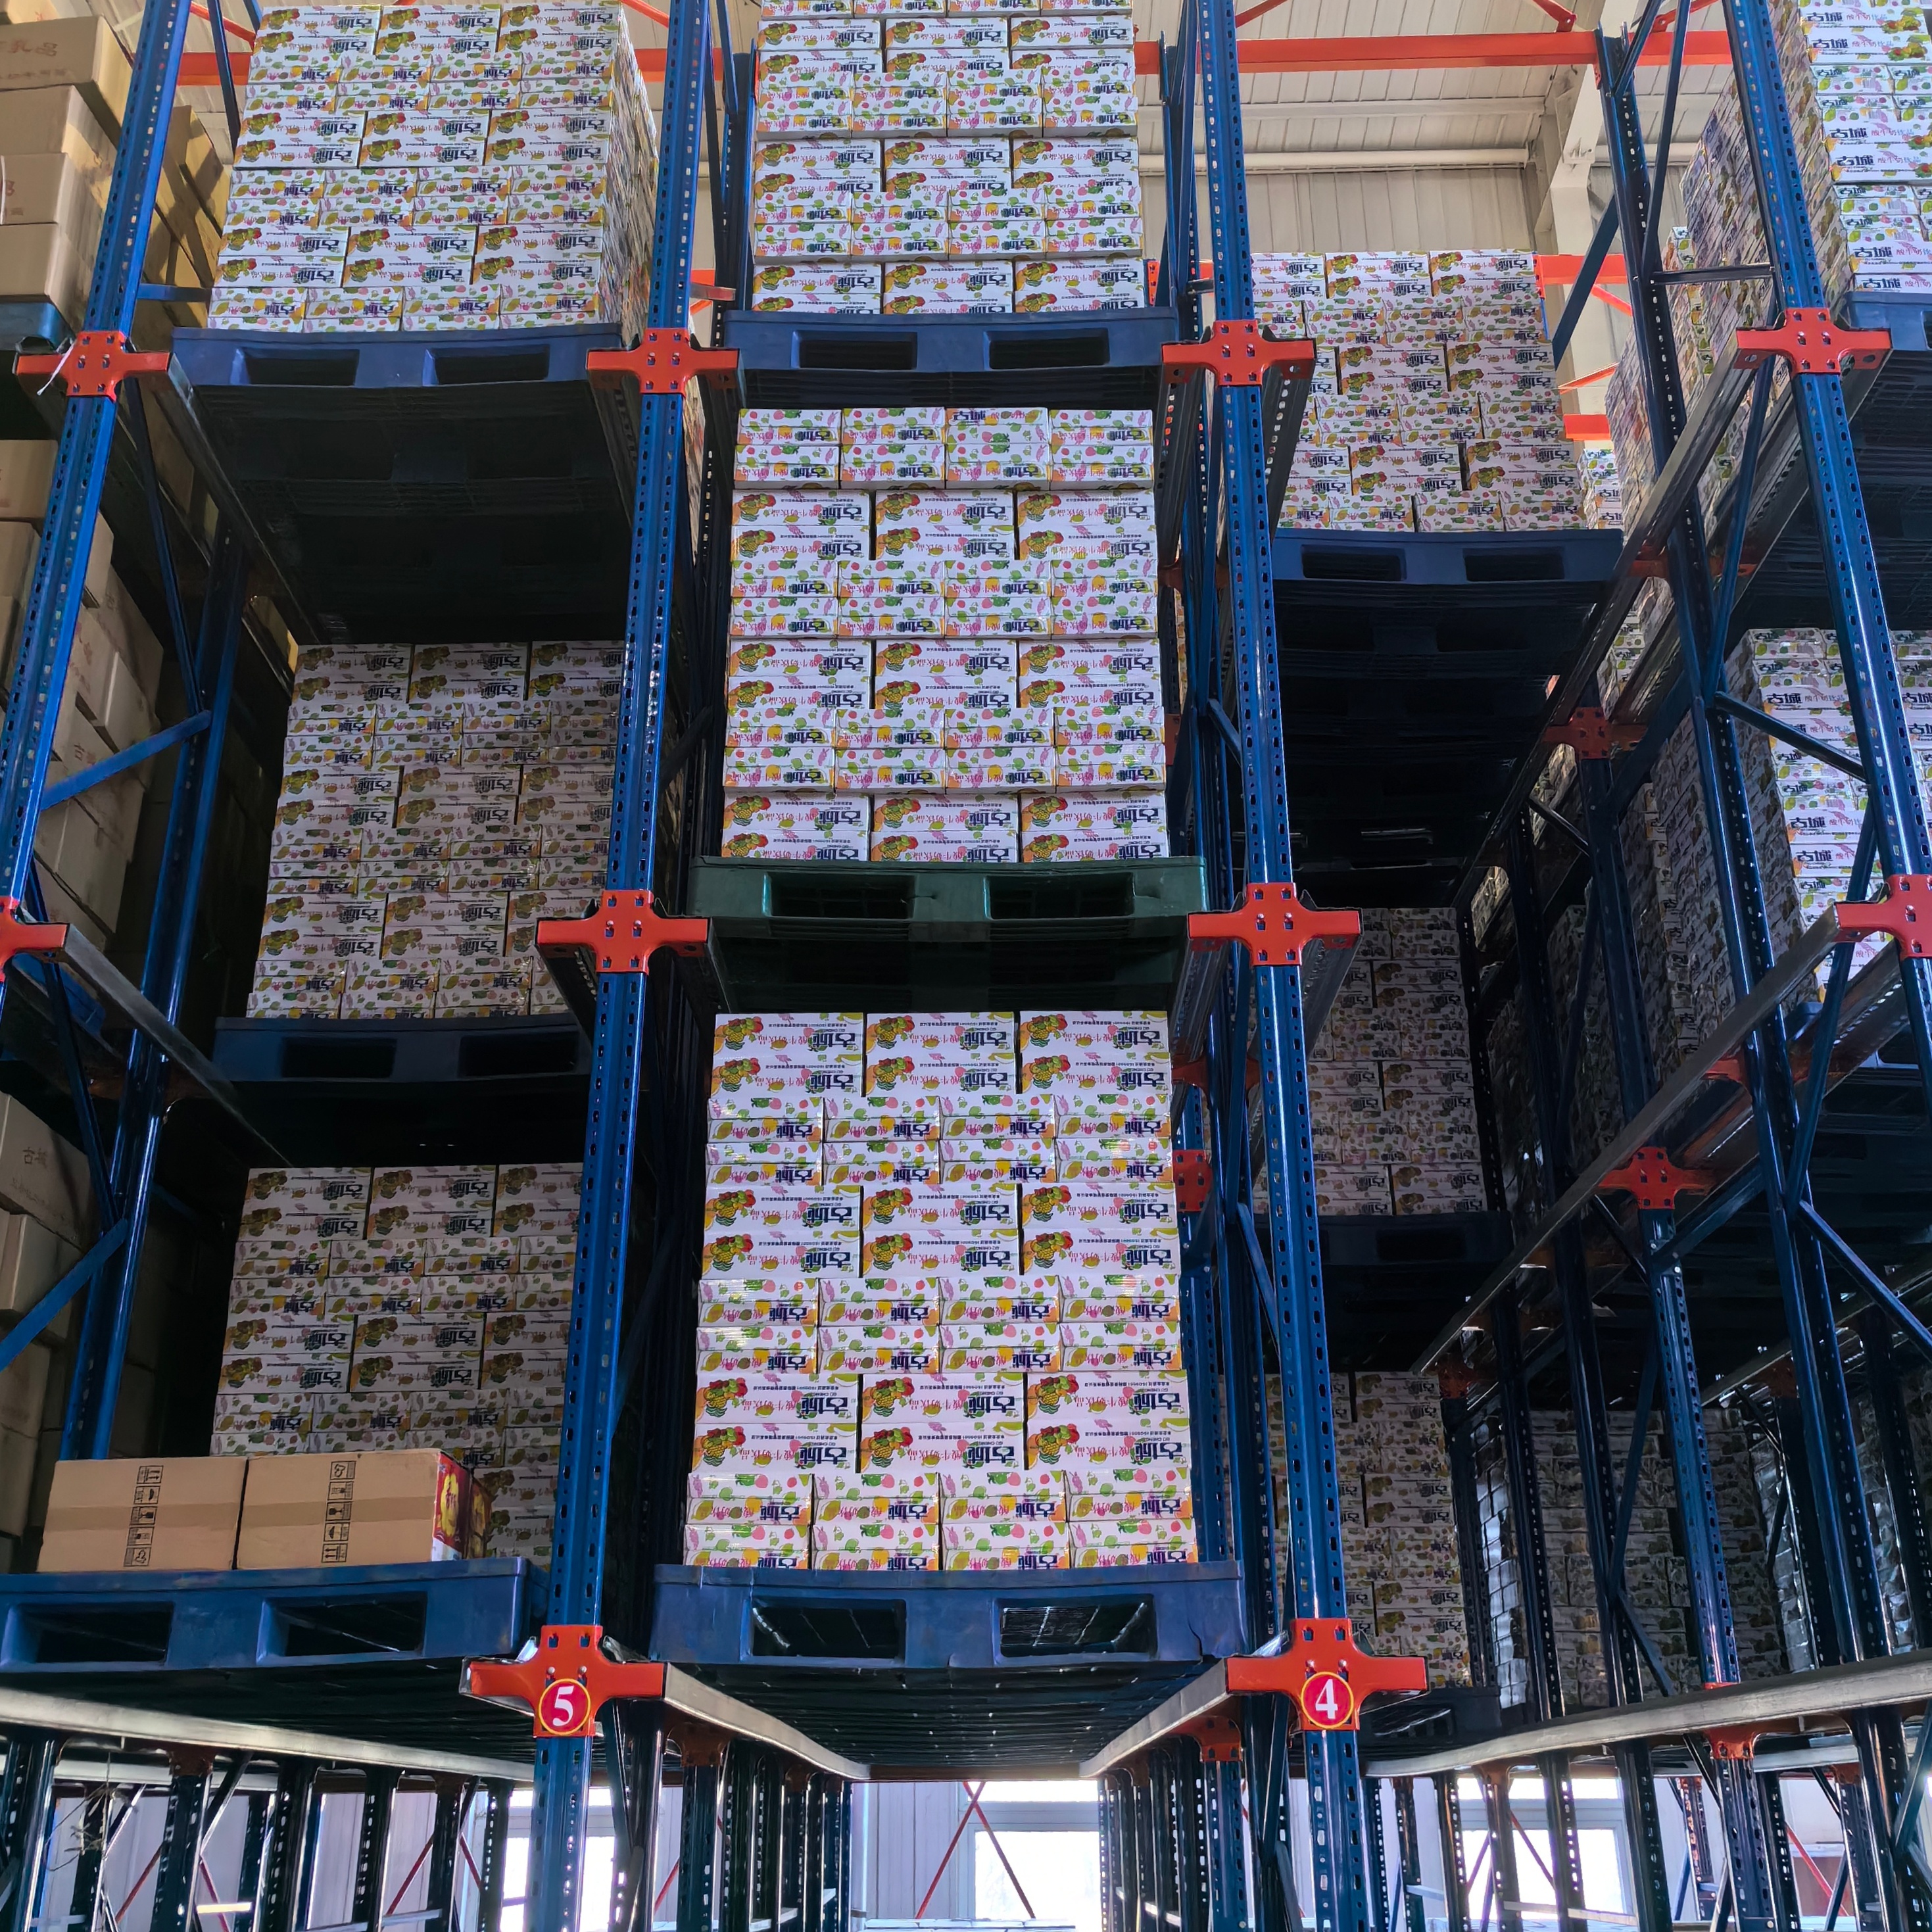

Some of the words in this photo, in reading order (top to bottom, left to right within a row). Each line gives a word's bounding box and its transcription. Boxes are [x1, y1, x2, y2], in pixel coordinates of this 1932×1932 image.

[1807, 12, 1843, 22] 古城
[1812, 39, 1849, 48] 古城
[1830, 128, 1868, 138] 古城
[1835, 155, 1875, 166] 古城
[1853, 247, 1893, 257] 古城
[1862, 278, 1901, 289] 古城
[822, 507, 861, 519] 古城
[966, 506, 1005, 519] 古城
[1107, 506, 1147, 519] 古城
[821, 543, 861, 556] 古城
[967, 542, 1006, 554] 古城
[1110, 543, 1149, 556] 古城
[823, 657, 863, 671] 古城
[969, 656, 1009, 670] 古城
[1113, 657, 1153, 670] 古城
[821, 694, 861, 707] 古城
[968, 694, 1009, 708] 古城
[1113, 692, 1153, 705] 古城
[1767, 692, 1802, 704] 古城
[819, 810, 861, 824] 古城
[969, 812, 1011, 826] 古城
[1117, 809, 1158, 823] 古城
[1790, 816, 1827, 829] 古城
[1795, 850, 1833, 862] 古城
[812, 1033, 856, 1047] 古城
[964, 1032, 1007, 1046] 古城
[1117, 1031, 1161, 1045] 古城
[810, 1075, 854, 1089] 古城
[965, 1073, 1009, 1087] 古城
[1121, 1073, 1164, 1087] 古城
[775, 1125, 812, 1138] 古城
[893, 1124, 930, 1137] 古城
[1009, 1122, 1046, 1134] 古城
[1124, 1121, 1161, 1134] 古城
[775, 1170, 811, 1182] 古城
[892, 1169, 929, 1182] 古城
[1009, 1167, 1046, 1180] 古城
[1126, 1165, 1163, 1178] 古城
[807, 1207, 852, 1222] 古城
[964, 1205, 1009, 1220] 古城
[1123, 1203, 1169, 1219] 古城
[805, 1252, 852, 1268] 古城
[965, 1251, 1010, 1267] 古城
[1125, 1249, 1172, 1265] 古城
[768, 1308, 807, 1320] 古城
[890, 1308, 929, 1320] 古城
[1011, 1305, 1050, 1318] 古城
[1130, 1305, 1169, 1317] 古城
[767, 1356, 806, 1370] 古城
[890, 1356, 929, 1369] 古城
[1011, 1354, 1050, 1367] 古城
[1132, 1352, 1171, 1365] 古城
[801, 1397, 848, 1414] 古城
[968, 1396, 1015, 1413] 古城
[1133, 1393, 1180, 1410] 古城
[800, 1447, 848, 1464] 古城
[967, 1446, 1015, 1464] 古城
[1135, 1442, 1183, 1460] 古城
[760, 1506, 800, 1520] 古城
[887, 1505, 927, 1519] 古城
[1015, 1503, 1055, 1516] 古城
[1140, 1500, 1180, 1514] 古城
[1315, 1678, 1338, 1719] 4
[552, 1685, 574, 1726] 5
